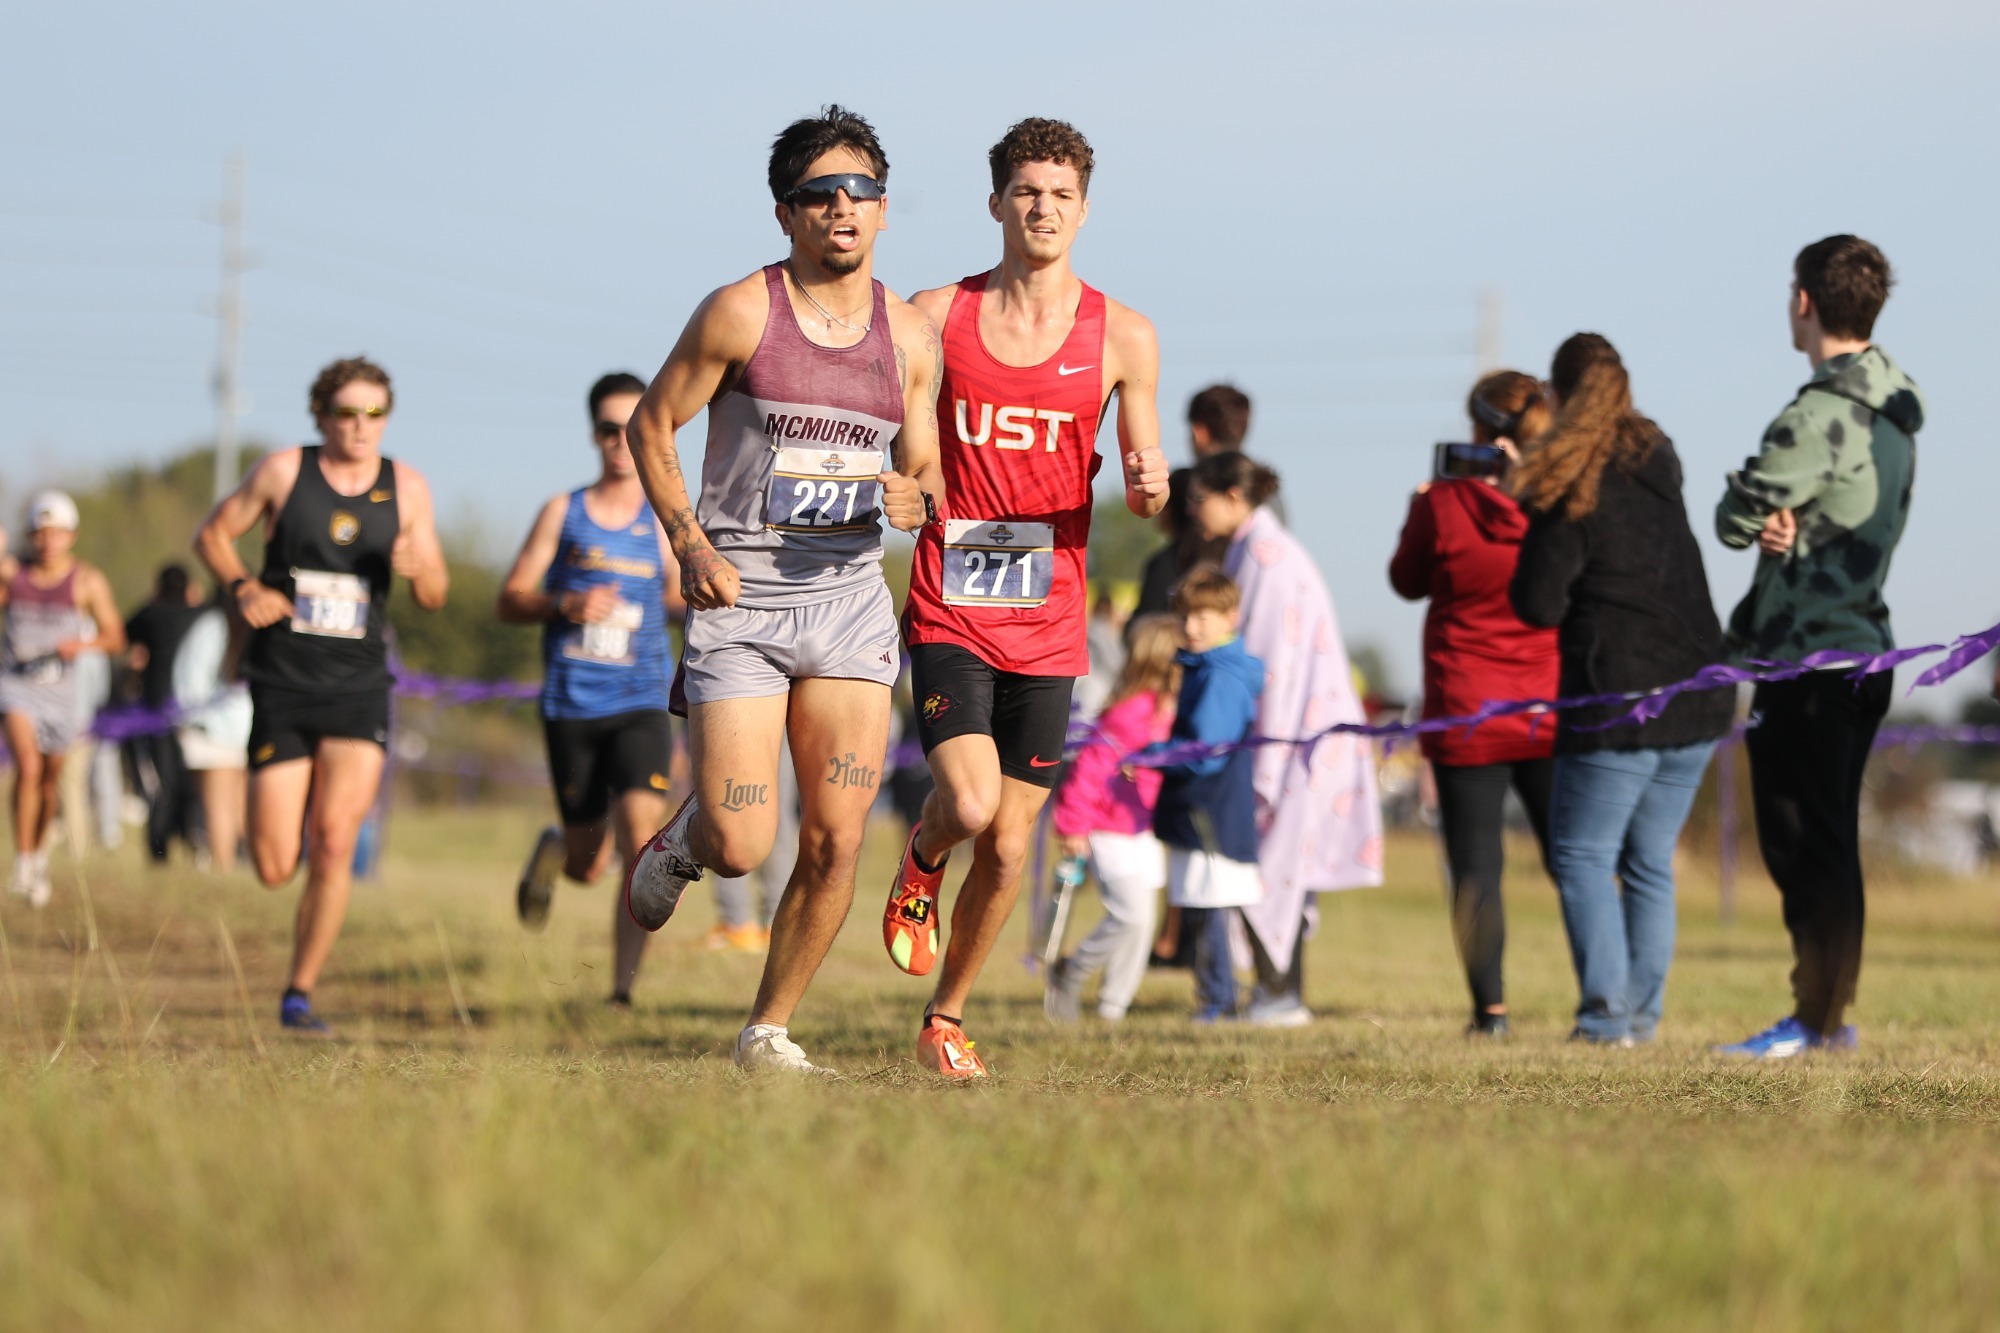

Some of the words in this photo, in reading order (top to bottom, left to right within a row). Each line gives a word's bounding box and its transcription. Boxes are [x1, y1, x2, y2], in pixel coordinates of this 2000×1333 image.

[764, 412, 879, 449] MCMURRY
[955, 399, 1075, 452] UST
[790, 480, 859, 526] 221
[963, 550, 1032, 597] 271
[826, 752, 876, 789] Hate
[720, 778, 768, 813] Love
